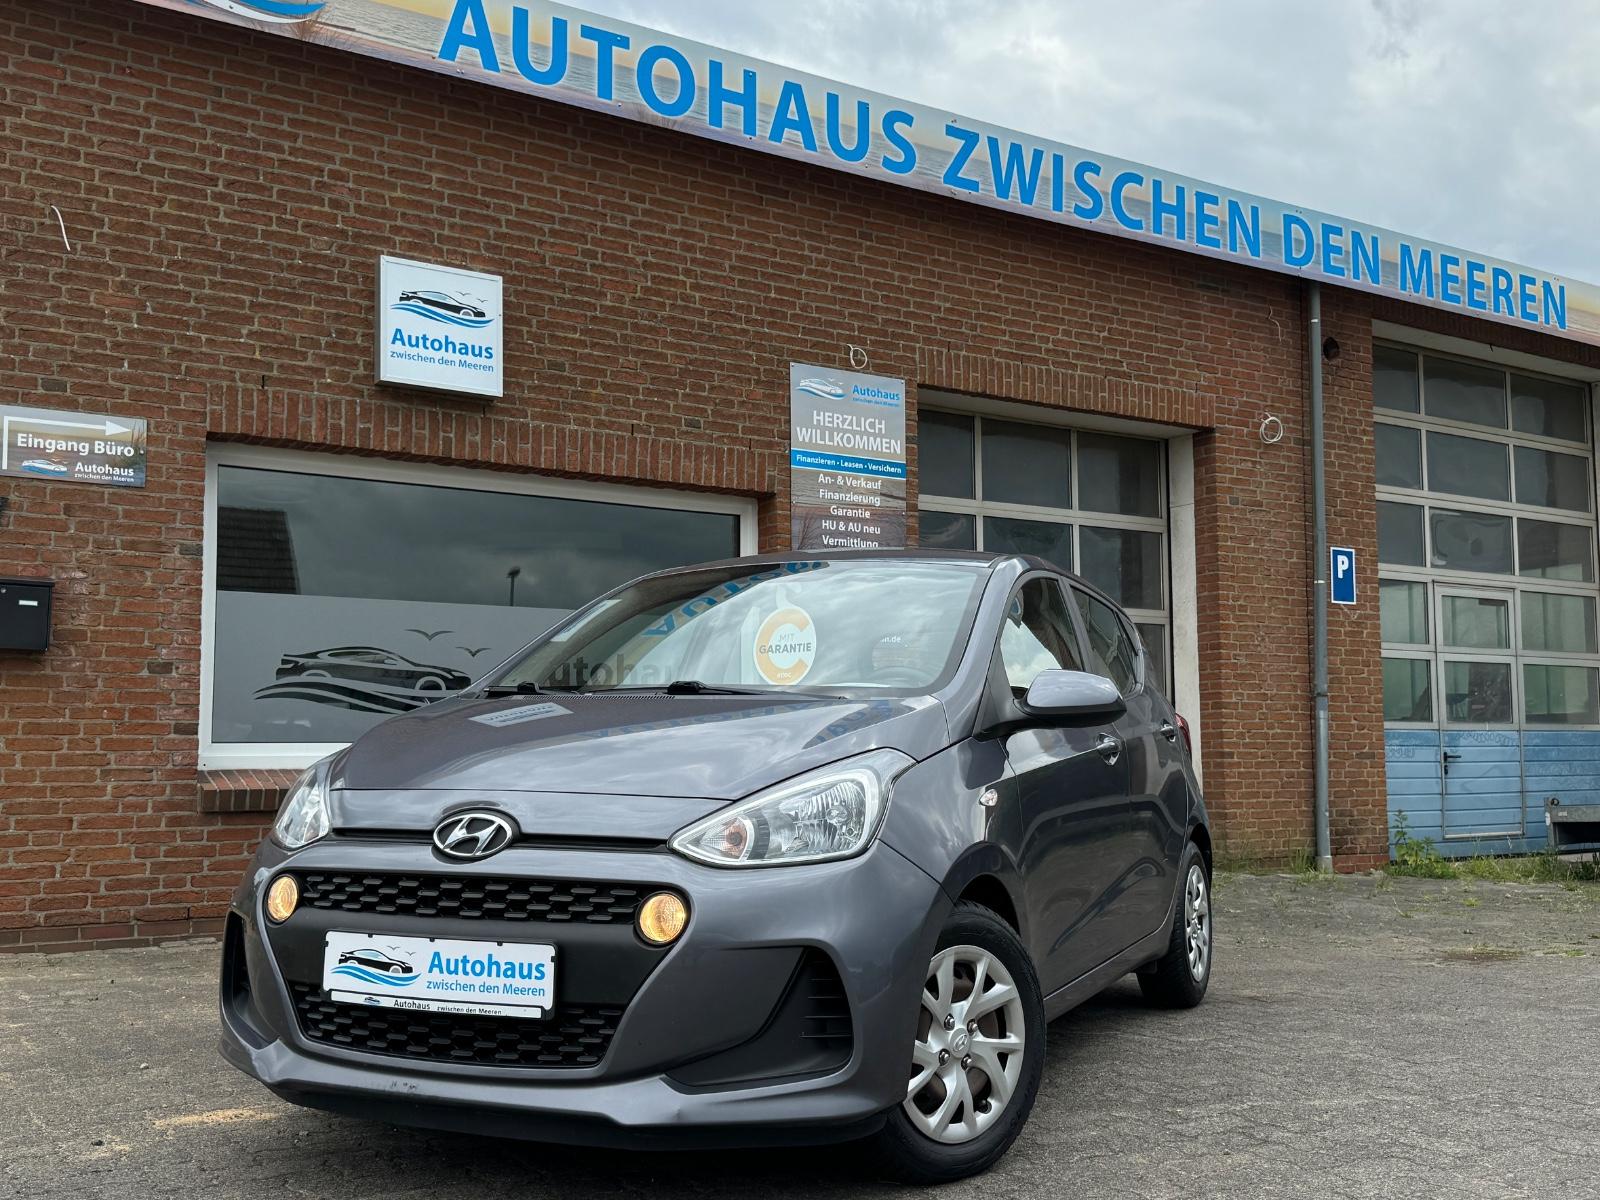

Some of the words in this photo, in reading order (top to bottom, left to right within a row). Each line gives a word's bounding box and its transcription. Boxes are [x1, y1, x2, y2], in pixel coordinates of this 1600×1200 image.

[437, 0, 918, 174] AUTOHAUS
[942, 124, 1260, 257] ZWISCHEN
[1282, 215, 1381, 285] DEN
[1399, 243, 1567, 330] MEEREN
[390, 328, 494, 360] Autohaus
[390, 350, 435, 363] zwischen
[437, 356, 456, 366] den
[458, 359, 494, 372] Meeren
[852, 385, 900, 400] Autohaus
[813, 410, 886, 434] HERZLICH
[17, 433, 90, 456] Eingang
[94, 440, 135, 457] Büro
[796, 427, 901, 454] WILLKOMMEN
[75, 461, 134, 476] Autohaus
[796, 455, 836, 466] Finanzieren
[840, 460, 863, 469] Leasen
[868, 463, 902, 473] Versichern
[818, 473, 835, 484] An-
[836, 475, 844, 485] &
[845, 476, 882, 489] Verkauf
[819, 489, 881, 506] Finanzierung
[830, 505, 871, 518] Garantie
[822, 520, 836, 530] HU
[838, 521, 846, 531] &
[848, 522, 861, 532] AU
[863, 525, 881, 534] neu
[1337, 554, 1349, 579] P
[759, 642, 812, 654] GARANTIE
[428, 951, 546, 980] Autohaus
[426, 979, 476, 992] zwischen
[478, 981, 499, 994] den
[502, 983, 546, 996] Meeren
[393, 999, 431, 1010] Autohaus
